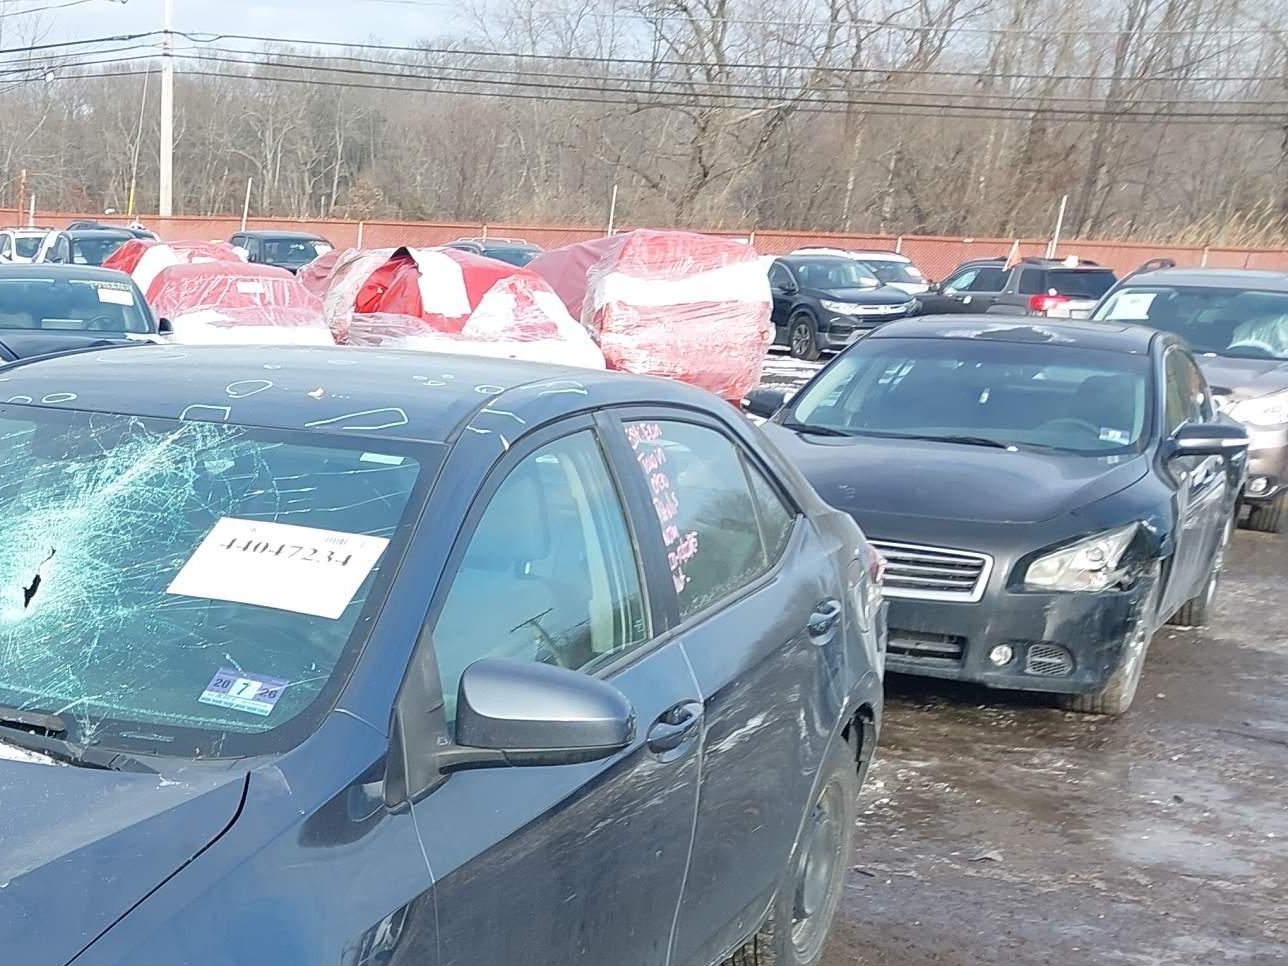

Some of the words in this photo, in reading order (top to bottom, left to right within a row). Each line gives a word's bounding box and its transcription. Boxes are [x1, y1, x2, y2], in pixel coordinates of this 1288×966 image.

[219, 537, 353, 567] 44047234
[213, 678, 231, 689] 20
[236, 682, 250, 696] 7
[259, 687, 278, 699] 26
